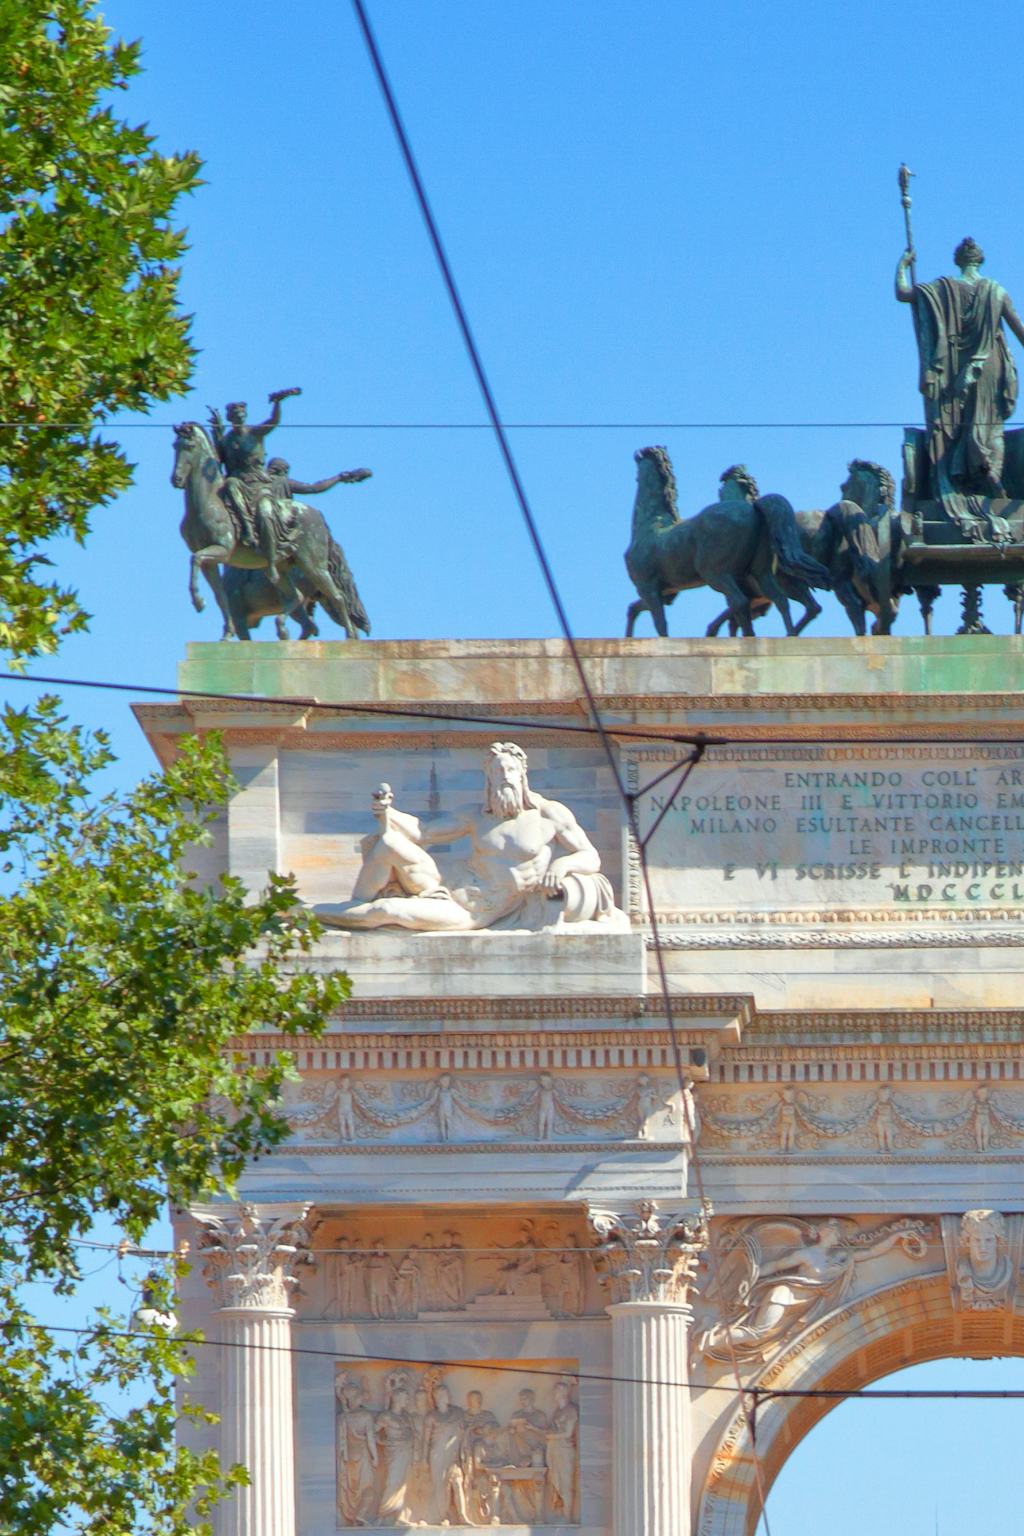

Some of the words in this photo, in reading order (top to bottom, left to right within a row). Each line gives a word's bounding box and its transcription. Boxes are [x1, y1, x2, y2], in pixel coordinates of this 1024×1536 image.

[784, 771, 902, 788] ENTRANDO
[650, 794, 781, 812] NAPOLEONE
[801, 794, 822, 811] III
[841, 794, 853, 810] E
[872, 793, 979, 809] VITTORIO
[690, 817, 777, 834] MILANO
[796, 816, 915, 833] ESULTANTE
[850, 839, 872, 855] LE
[891, 838, 1004, 855] IMPRONTE
[723, 862, 736, 881] E
[755, 860, 779, 881] VI
[795, 862, 881, 881] SCRISSE
